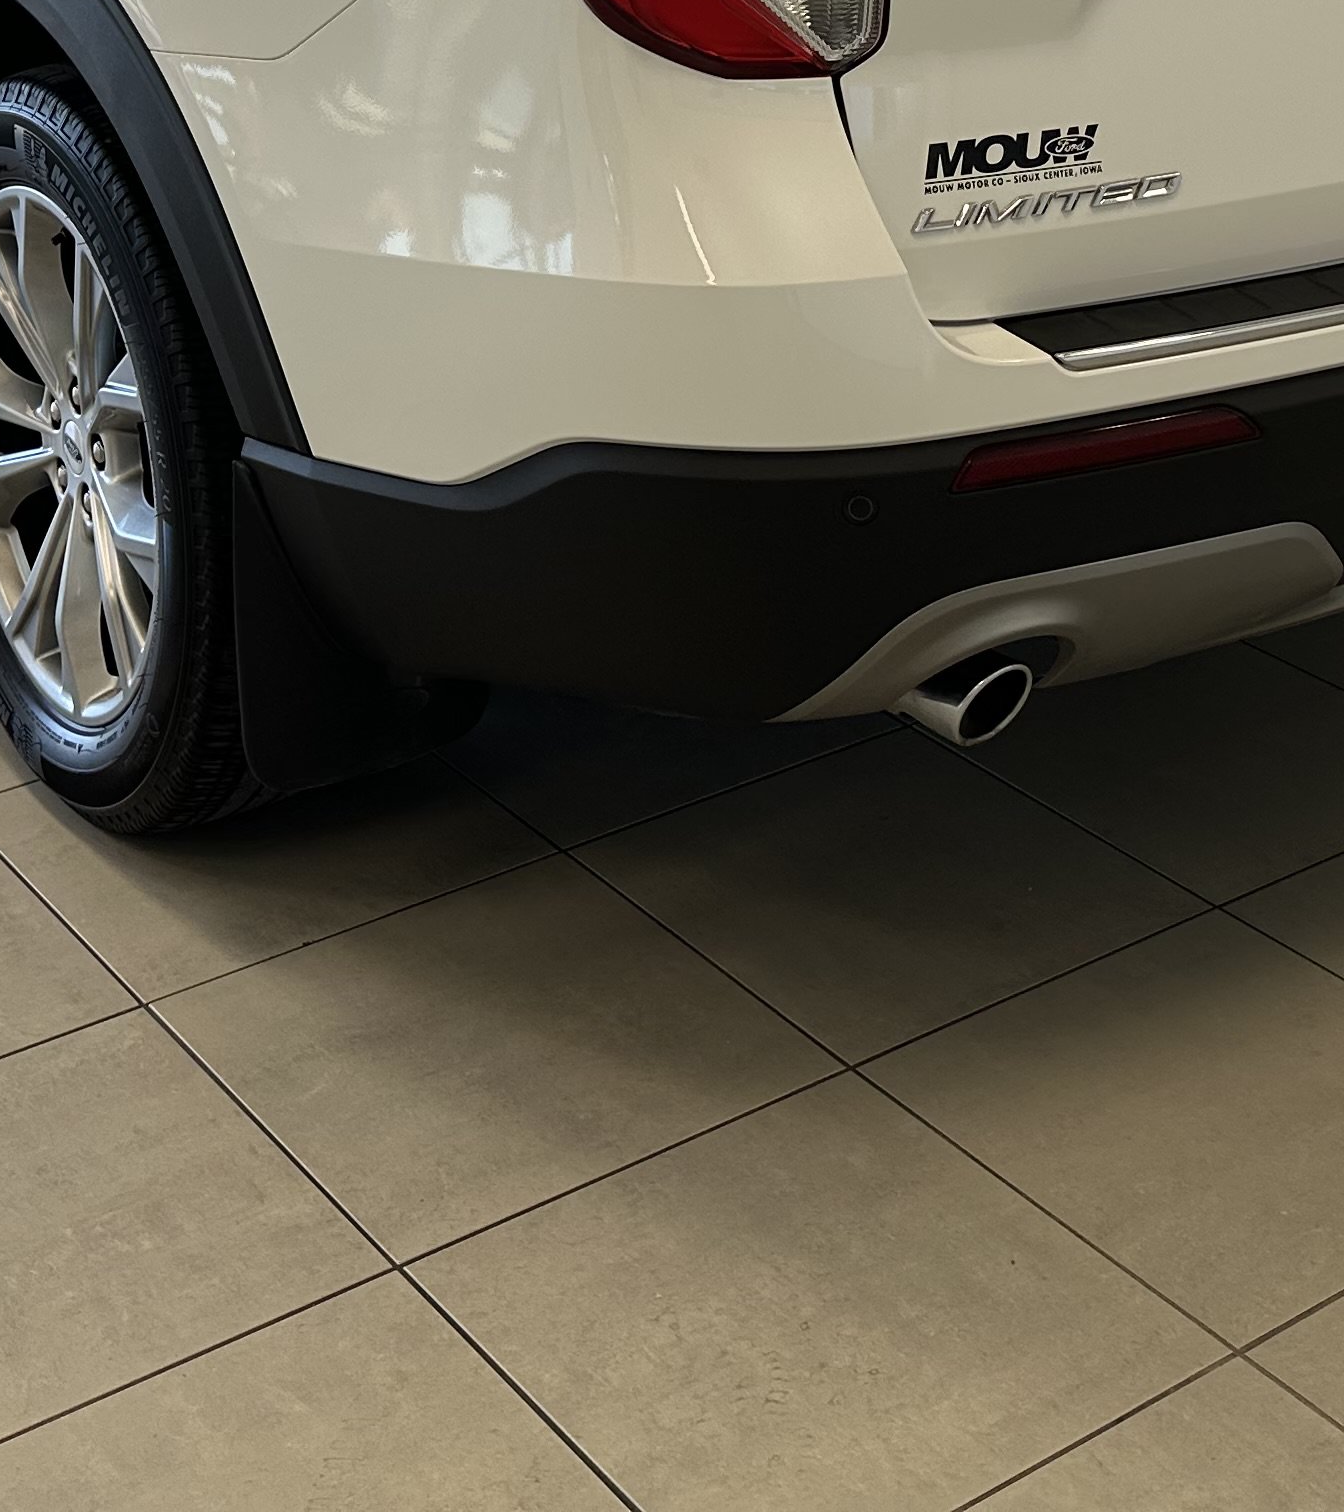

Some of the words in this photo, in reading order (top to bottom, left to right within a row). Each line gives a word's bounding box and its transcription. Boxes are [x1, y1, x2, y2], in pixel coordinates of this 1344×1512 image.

[1055, 138, 1087, 154] Ford
[910, 170, 1183, 235] LIMITED
[923, 184, 955, 196] MOUW
[957, 179, 990, 192] MOTOR
[992, 177, 1004, 188] CO
[1013, 173, 1041, 185] SIOUX
[1043, 169, 1078, 180] CENTER,
[1079, 164, 1104, 175] IOWA
[49, 163, 132, 318] MICHELIN
